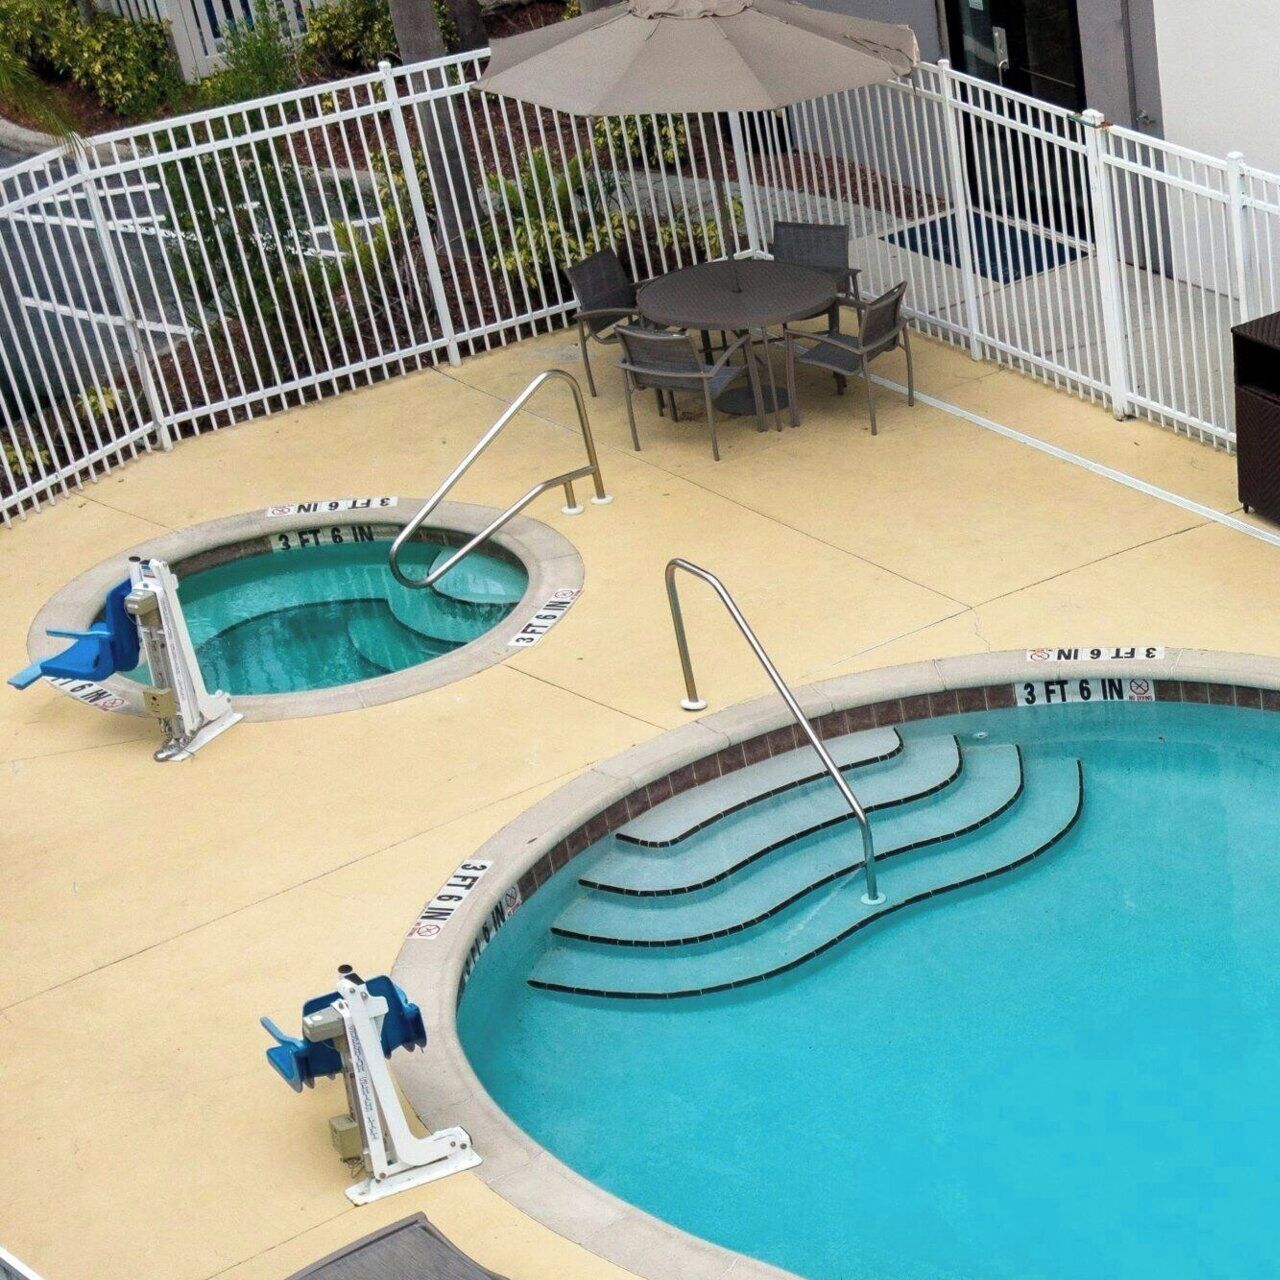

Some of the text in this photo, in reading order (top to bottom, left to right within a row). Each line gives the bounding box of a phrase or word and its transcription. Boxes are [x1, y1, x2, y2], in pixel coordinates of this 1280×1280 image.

[297, 498, 390, 513] 3 FT 6 IN
[278, 525, 374, 550] 3 FT 6 IN
[521, 623, 548, 634] FT
[543, 601, 570, 611] IN
[1057, 648, 1157, 660] 3 FT 6 IN
[70, 683, 112, 703] 6 IN
[1024, 678, 1124, 704] 3 FT 6 IN
[447, 875, 480, 890] FT
[437, 894, 462, 902] 6
[420, 907, 454, 921] IN
[492, 900, 505, 932] IN
